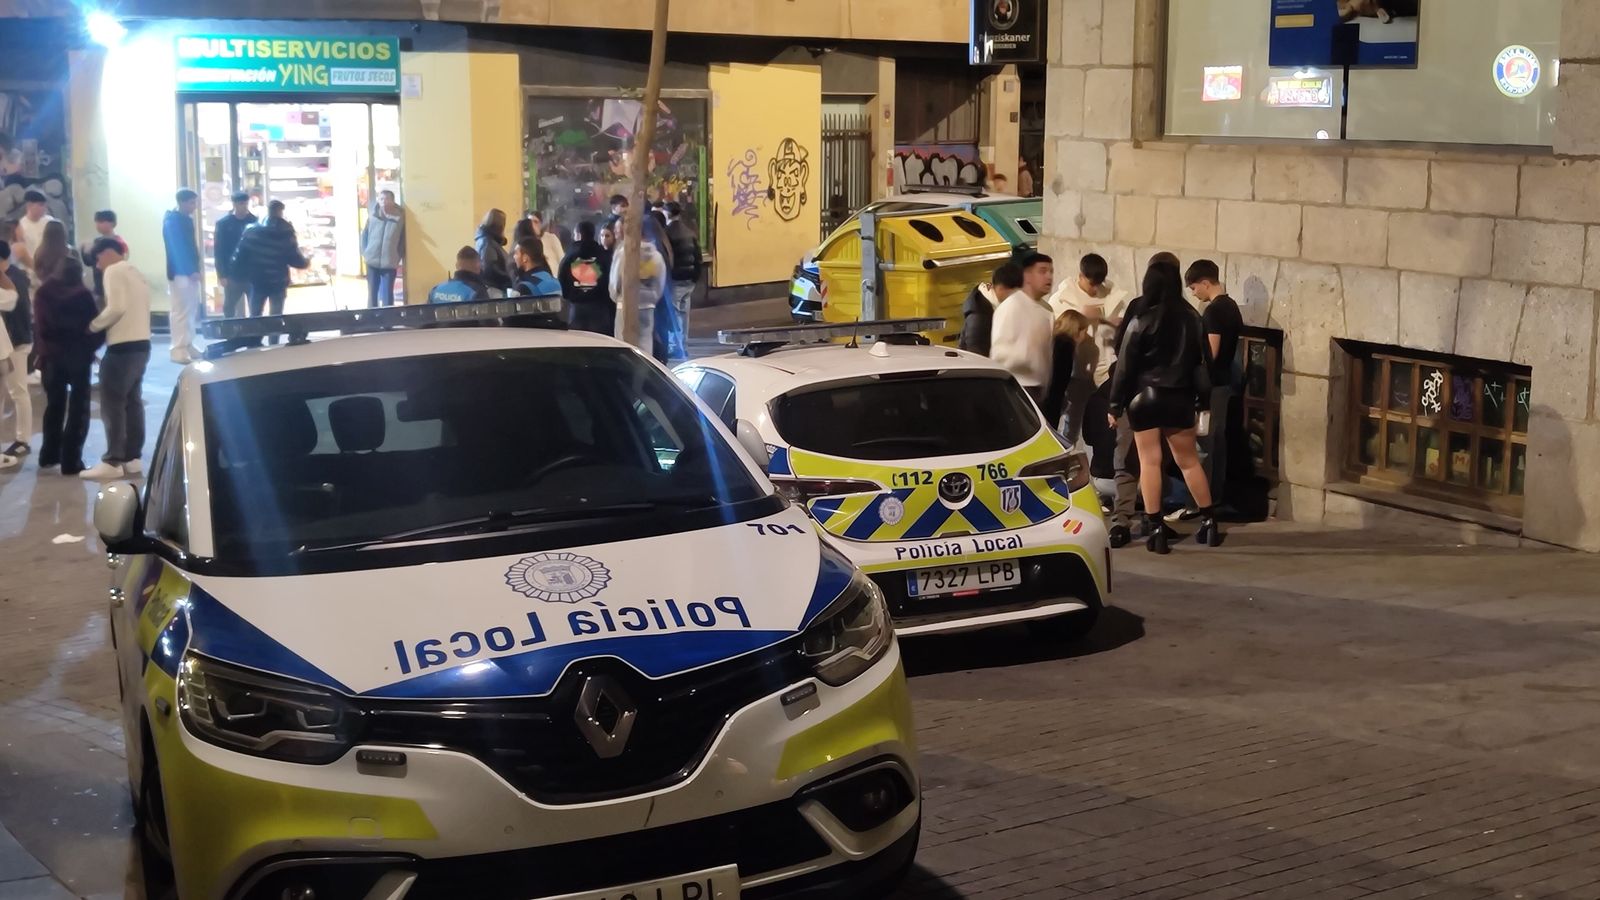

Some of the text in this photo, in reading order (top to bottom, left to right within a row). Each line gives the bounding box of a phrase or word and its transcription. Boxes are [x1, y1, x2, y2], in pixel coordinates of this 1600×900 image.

[278, 63, 329, 87] YING
[898, 471, 934, 486] 112
[976, 462, 1008, 481] 766
[746, 523, 807, 536] 701
[972, 534, 1024, 554] Local
[920, 562, 1016, 592] 7327 LPB
